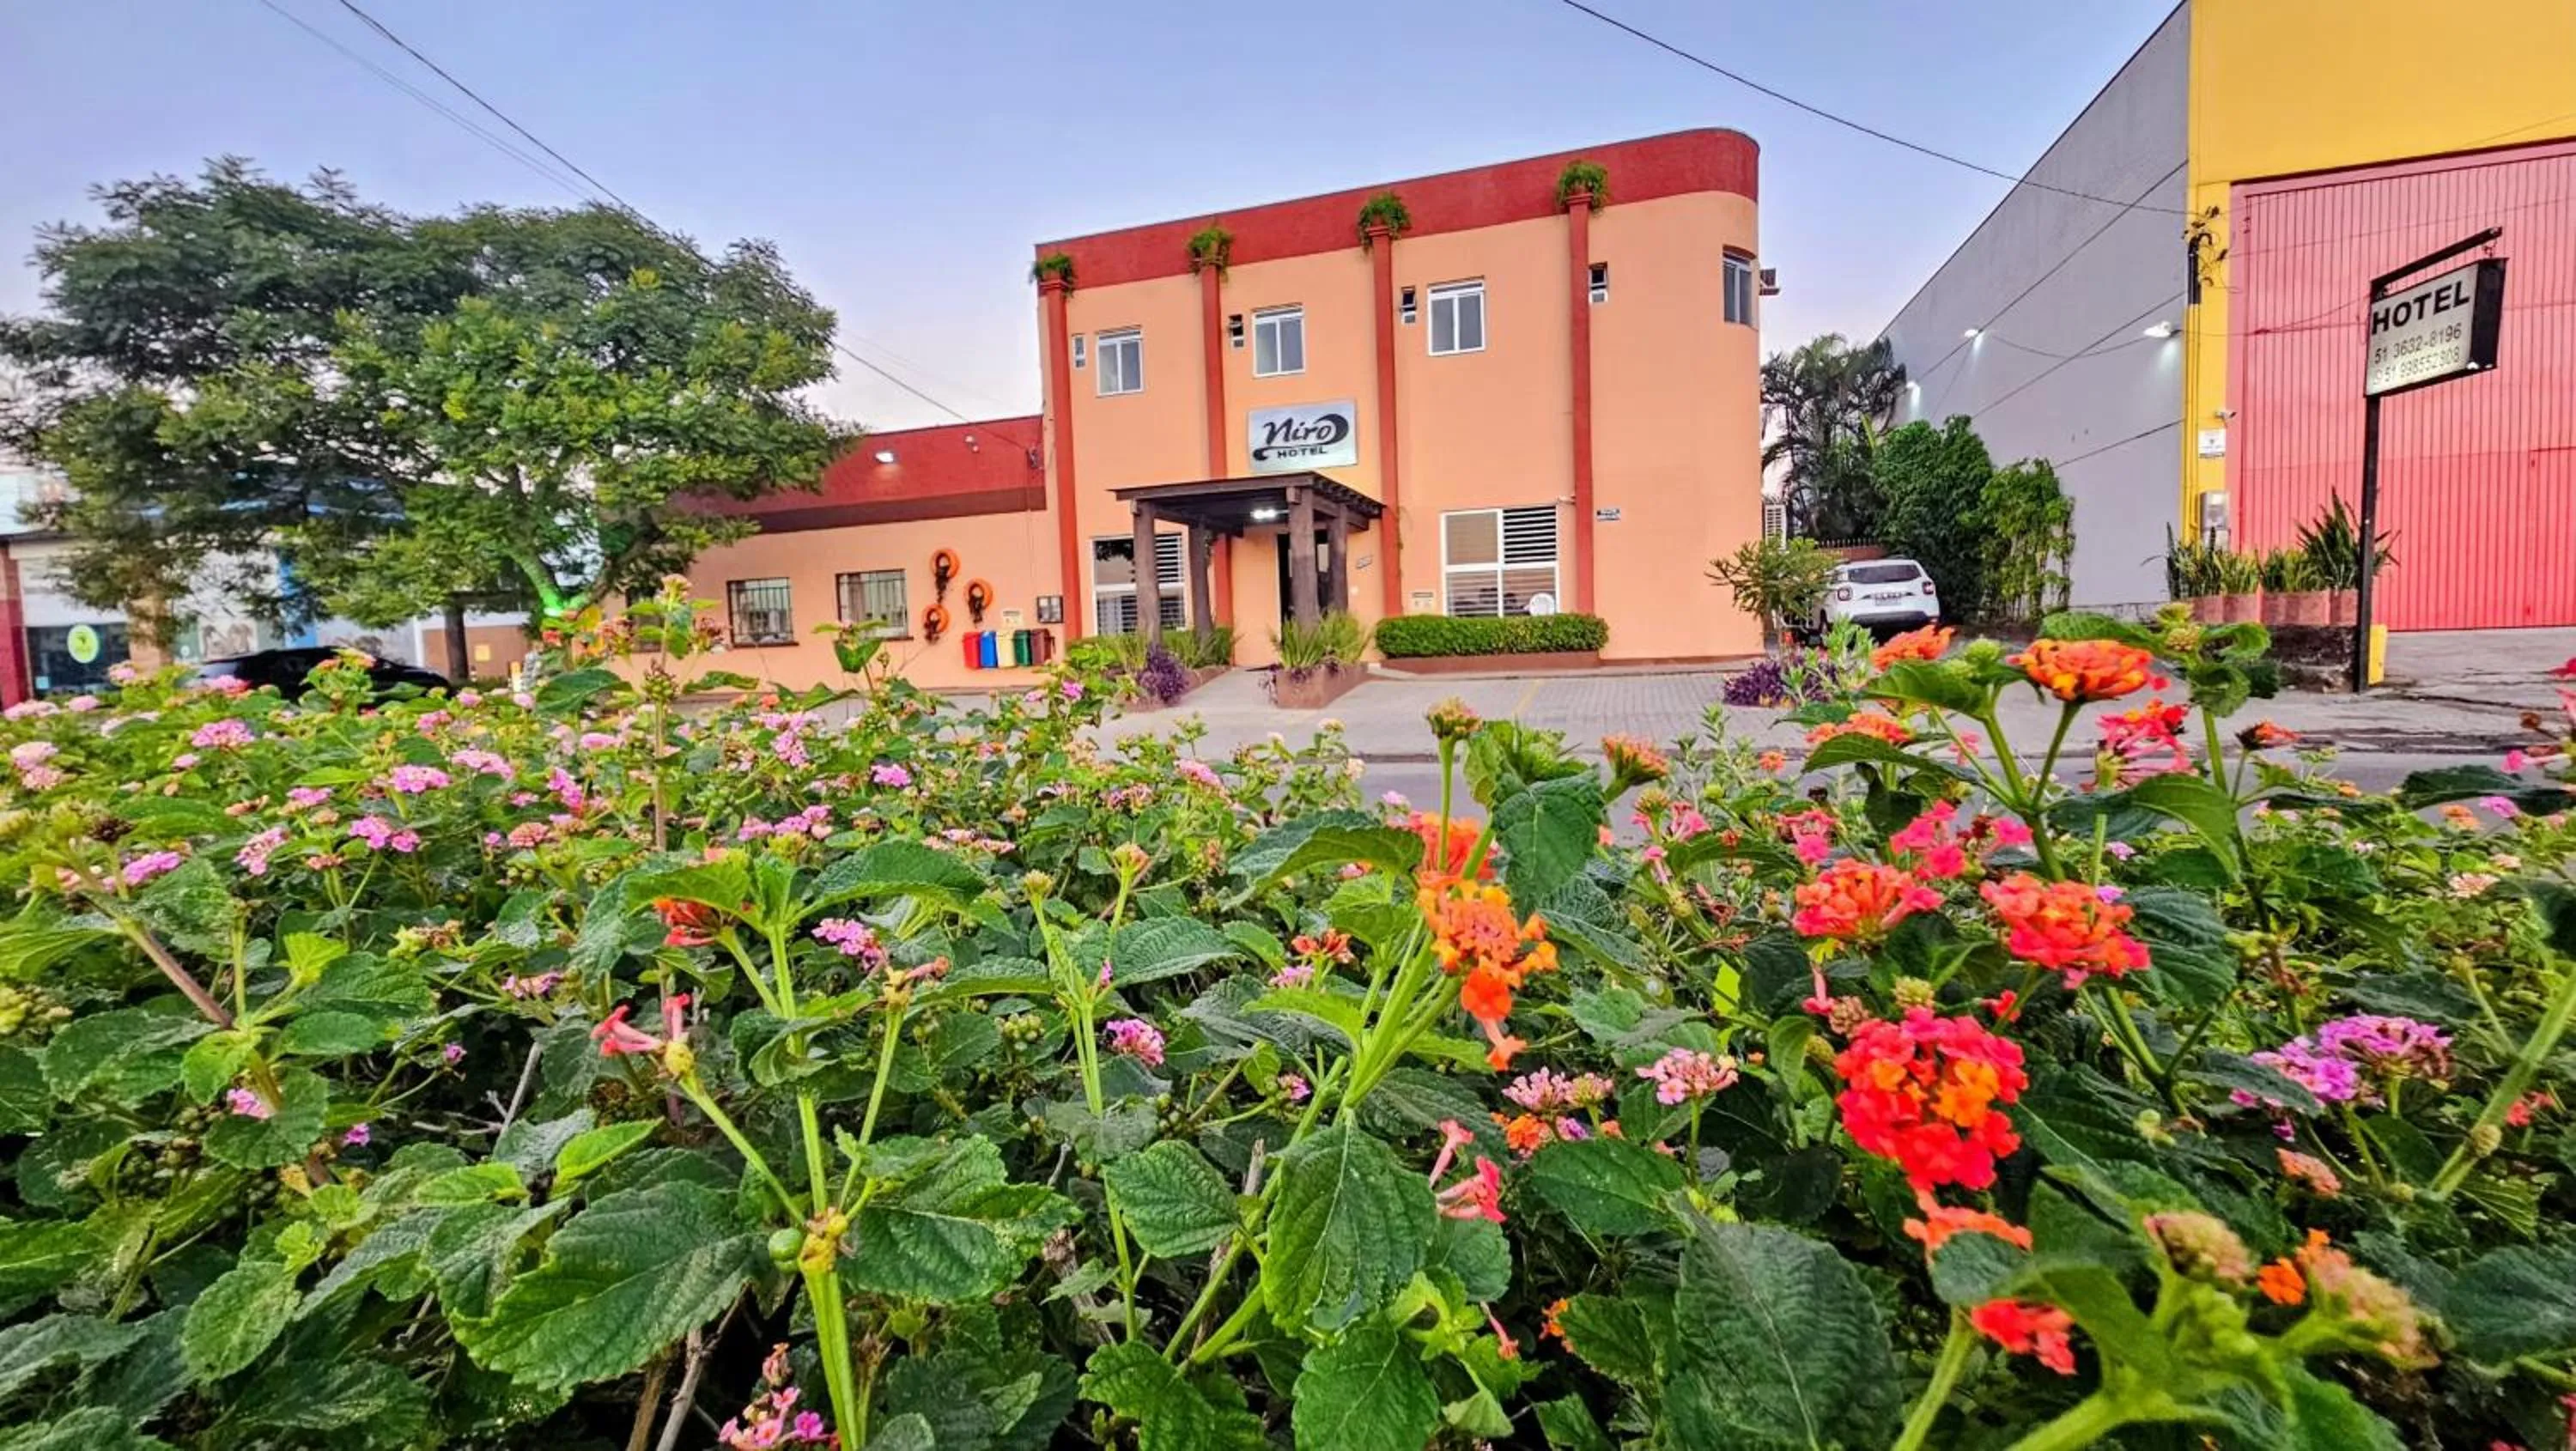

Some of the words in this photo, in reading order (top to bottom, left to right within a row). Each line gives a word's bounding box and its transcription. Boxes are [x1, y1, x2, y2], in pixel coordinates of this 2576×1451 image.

[2371, 281, 2470, 335] HOTEL
[2374, 348, 2387, 364] 51
[2393, 323, 2462, 358] 3632-8196
[2384, 366, 2396, 382] 51
[1278, 446, 1328, 458] HOTEL
